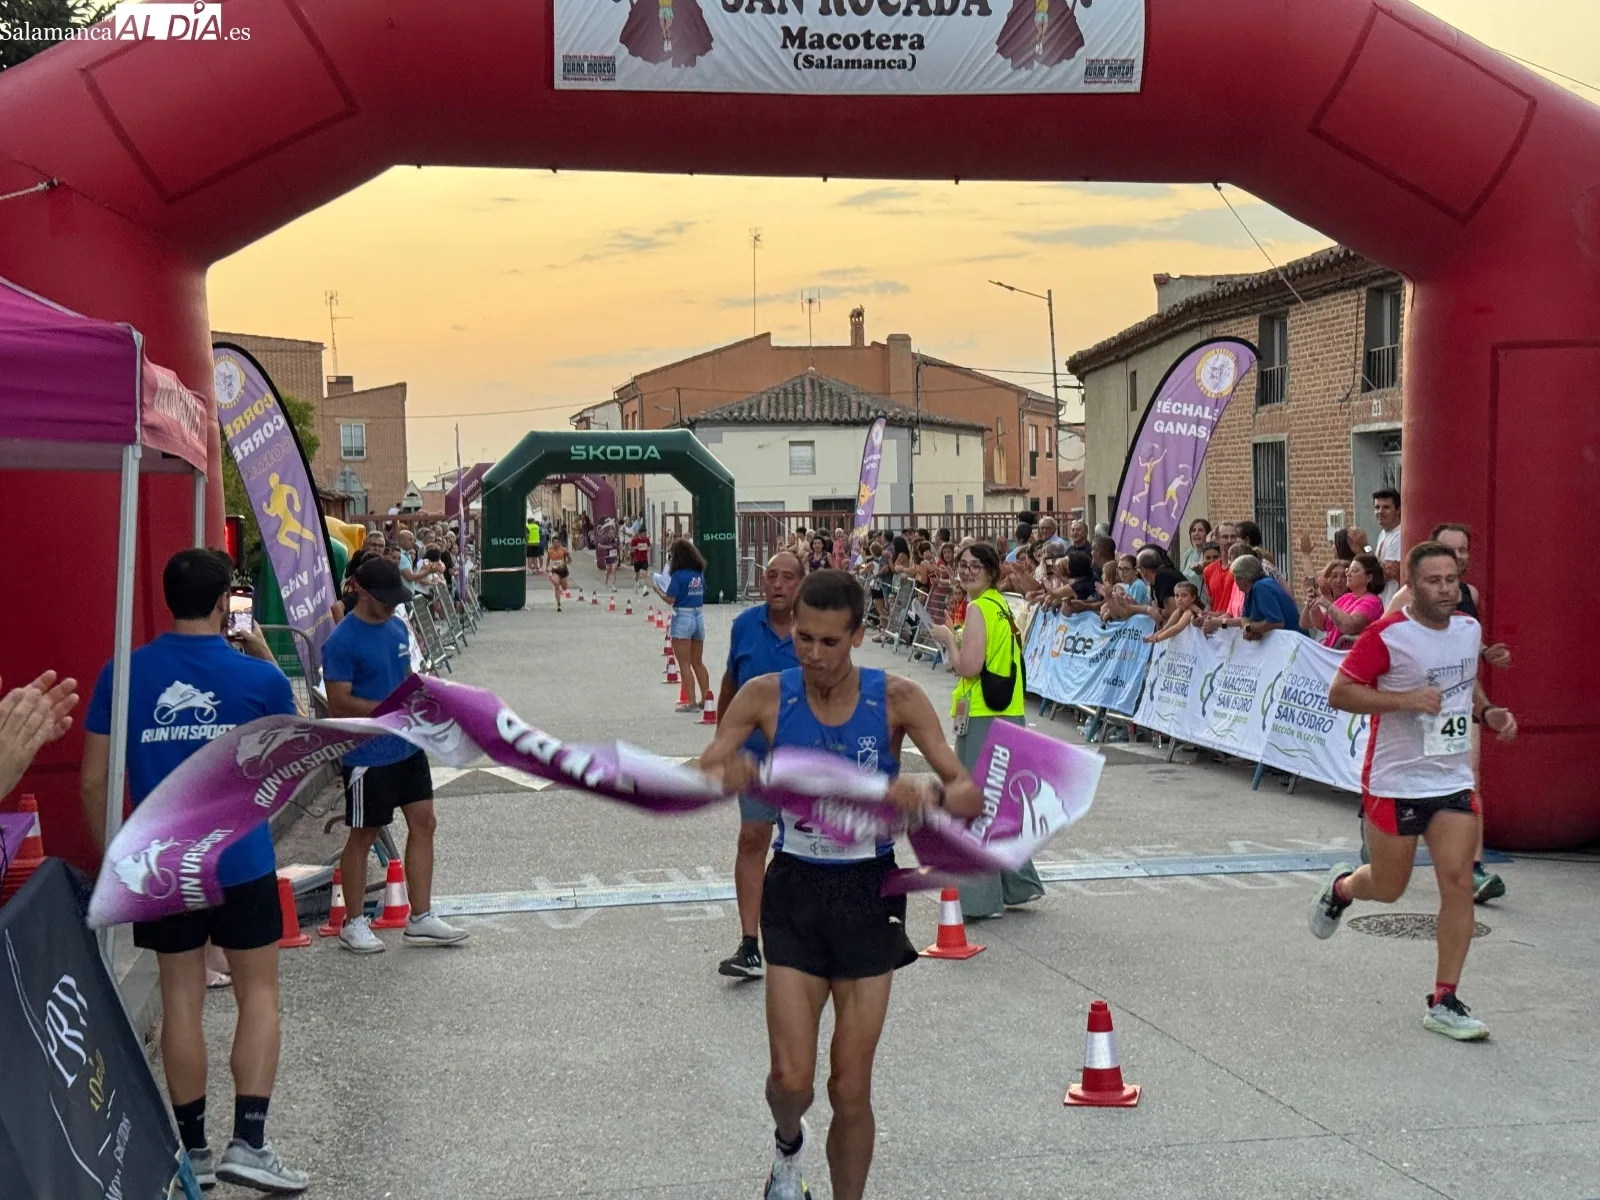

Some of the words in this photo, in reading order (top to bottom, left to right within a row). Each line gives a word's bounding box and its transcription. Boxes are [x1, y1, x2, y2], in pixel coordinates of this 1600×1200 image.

[781, 26, 926, 51] Macotera
[794, 52, 917, 71] (Salamanca)
[1222, 675, 1258, 695] MACOTERA
[1216, 693, 1232, 708] SAN
[1231, 696, 1253, 713] ISIDRO
[1275, 704, 1296, 725] SAN
[1296, 709, 1334, 734] ISIDRO
[1440, 716, 1467, 737] 49
